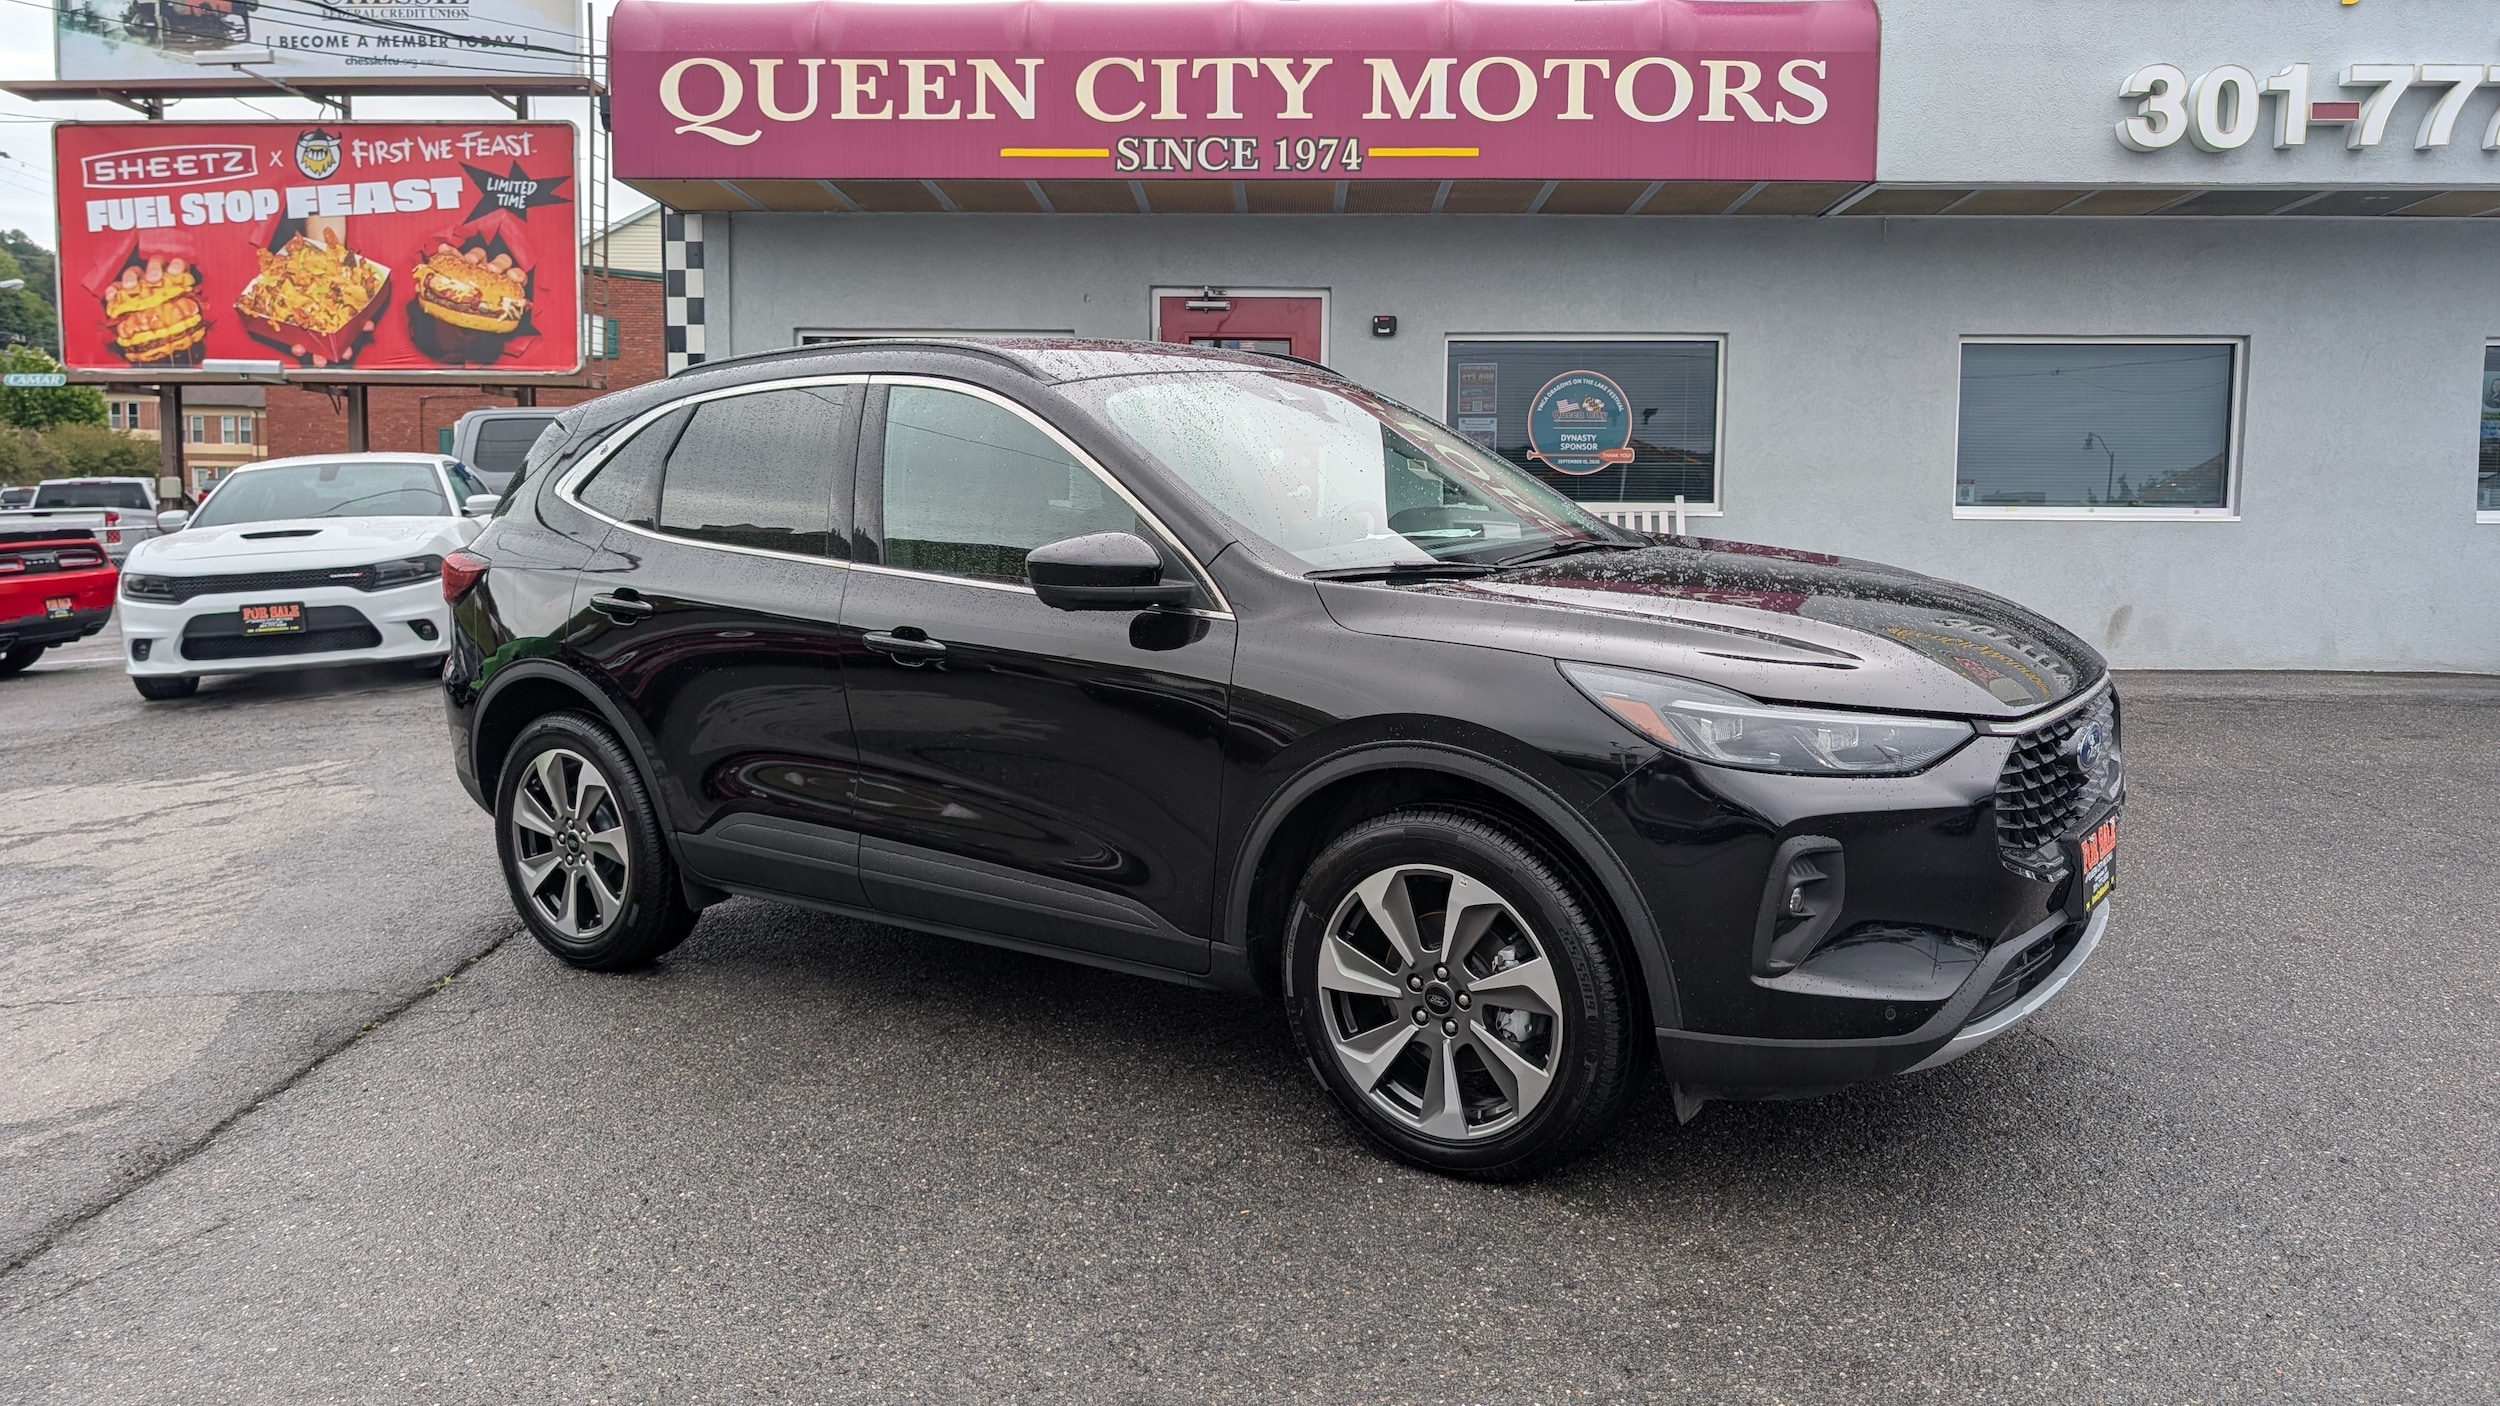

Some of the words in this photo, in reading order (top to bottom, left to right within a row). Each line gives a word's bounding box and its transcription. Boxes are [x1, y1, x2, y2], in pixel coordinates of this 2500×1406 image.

[380, 8, 427, 18] CREDIT
[429, 8, 469, 18] UNION
[279, 35, 350, 48] BECOME
[357, 35, 369, 48] A
[376, 35, 450, 48] MEMBER
[658, 57, 1044, 146] QUEEN
[1074, 57, 1334, 122] CITY
[1361, 56, 1828, 125] MOTORS
[2114, 62, 2500, 152] 301-77
[93, 151, 245, 182] SHEETZ
[350, 137, 414, 168] FIRST
[417, 135, 455, 162] WE
[456, 130, 534, 160] FEAST
[1115, 136, 1259, 172] SINCE
[1273, 136, 1364, 172] 1974
[486, 177, 538, 196] LIMITED
[85, 195, 177, 232] FUEL
[180, 189, 280, 226] STOP
[285, 176, 464, 220] FEAST
[496, 193, 527, 209] TIME
[8, 375, 61, 385] LAMAR
[1537, 397, 1549, 412] YMCA
[1546, 380, 1573, 398] DRAGONS
[1583, 378, 1594, 386] THE
[1593, 381, 1609, 392] LAKE
[1606, 389, 1625, 413] FESTIVAL
[1552, 410, 1585, 420] Queen
[1560, 434, 1597, 442] DYNASTY
[1560, 442, 1598, 451] SPONSOR
[243, 606, 269, 620] FOR
[269, 604, 300, 619] SALE
